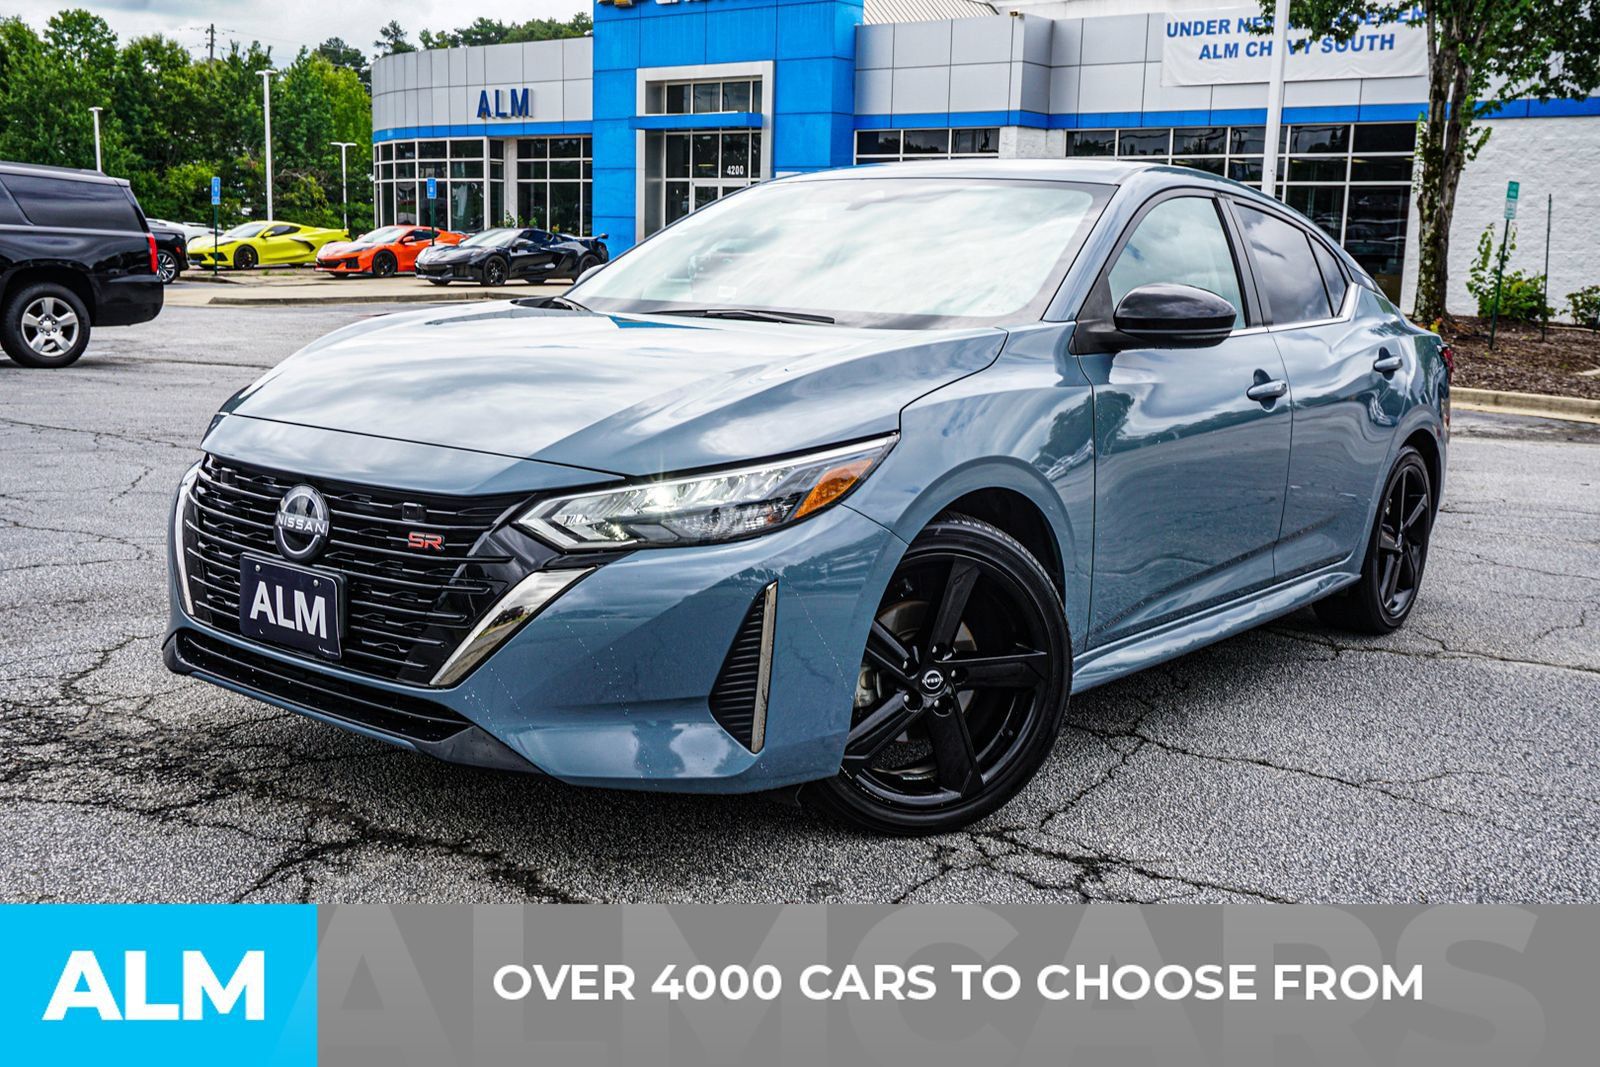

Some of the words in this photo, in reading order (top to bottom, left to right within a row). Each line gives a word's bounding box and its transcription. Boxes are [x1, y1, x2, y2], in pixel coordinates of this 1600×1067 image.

[1166, 18, 1231, 38] UNDER
[1237, 16, 1275, 34] NE
[1198, 42, 1240, 60] ALM
[1245, 35, 1313, 57] CHVY
[1320, 33, 1396, 54] SOUTH
[476, 87, 531, 119] ALM
[726, 164, 744, 176] 4200
[278, 513, 325, 534] NISSAN
[407, 531, 444, 551] SR
[249, 580, 327, 640] ALM
